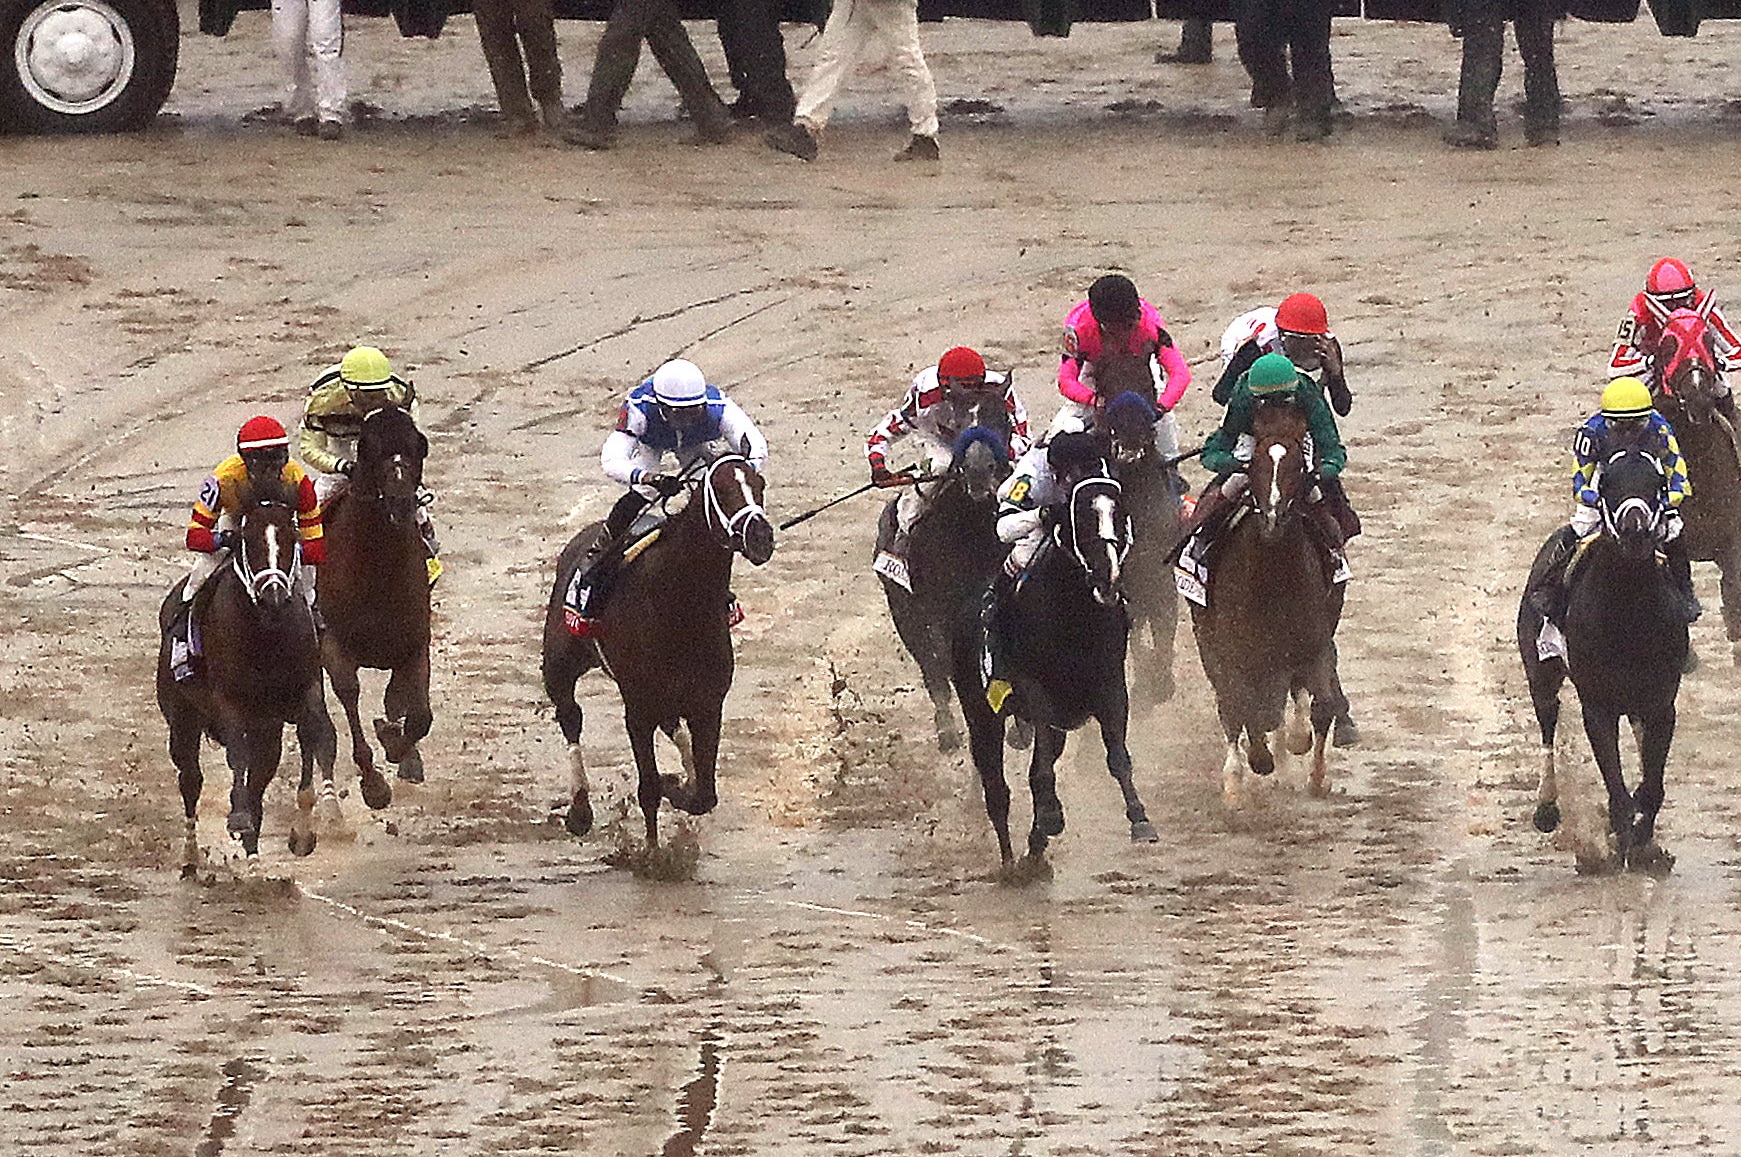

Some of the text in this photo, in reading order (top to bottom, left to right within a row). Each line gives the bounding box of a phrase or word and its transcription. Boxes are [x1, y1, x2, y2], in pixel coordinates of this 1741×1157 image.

[1617, 319, 1633, 339] 15
[1575, 430, 1591, 456] 10
[199, 481, 216, 507] 21
